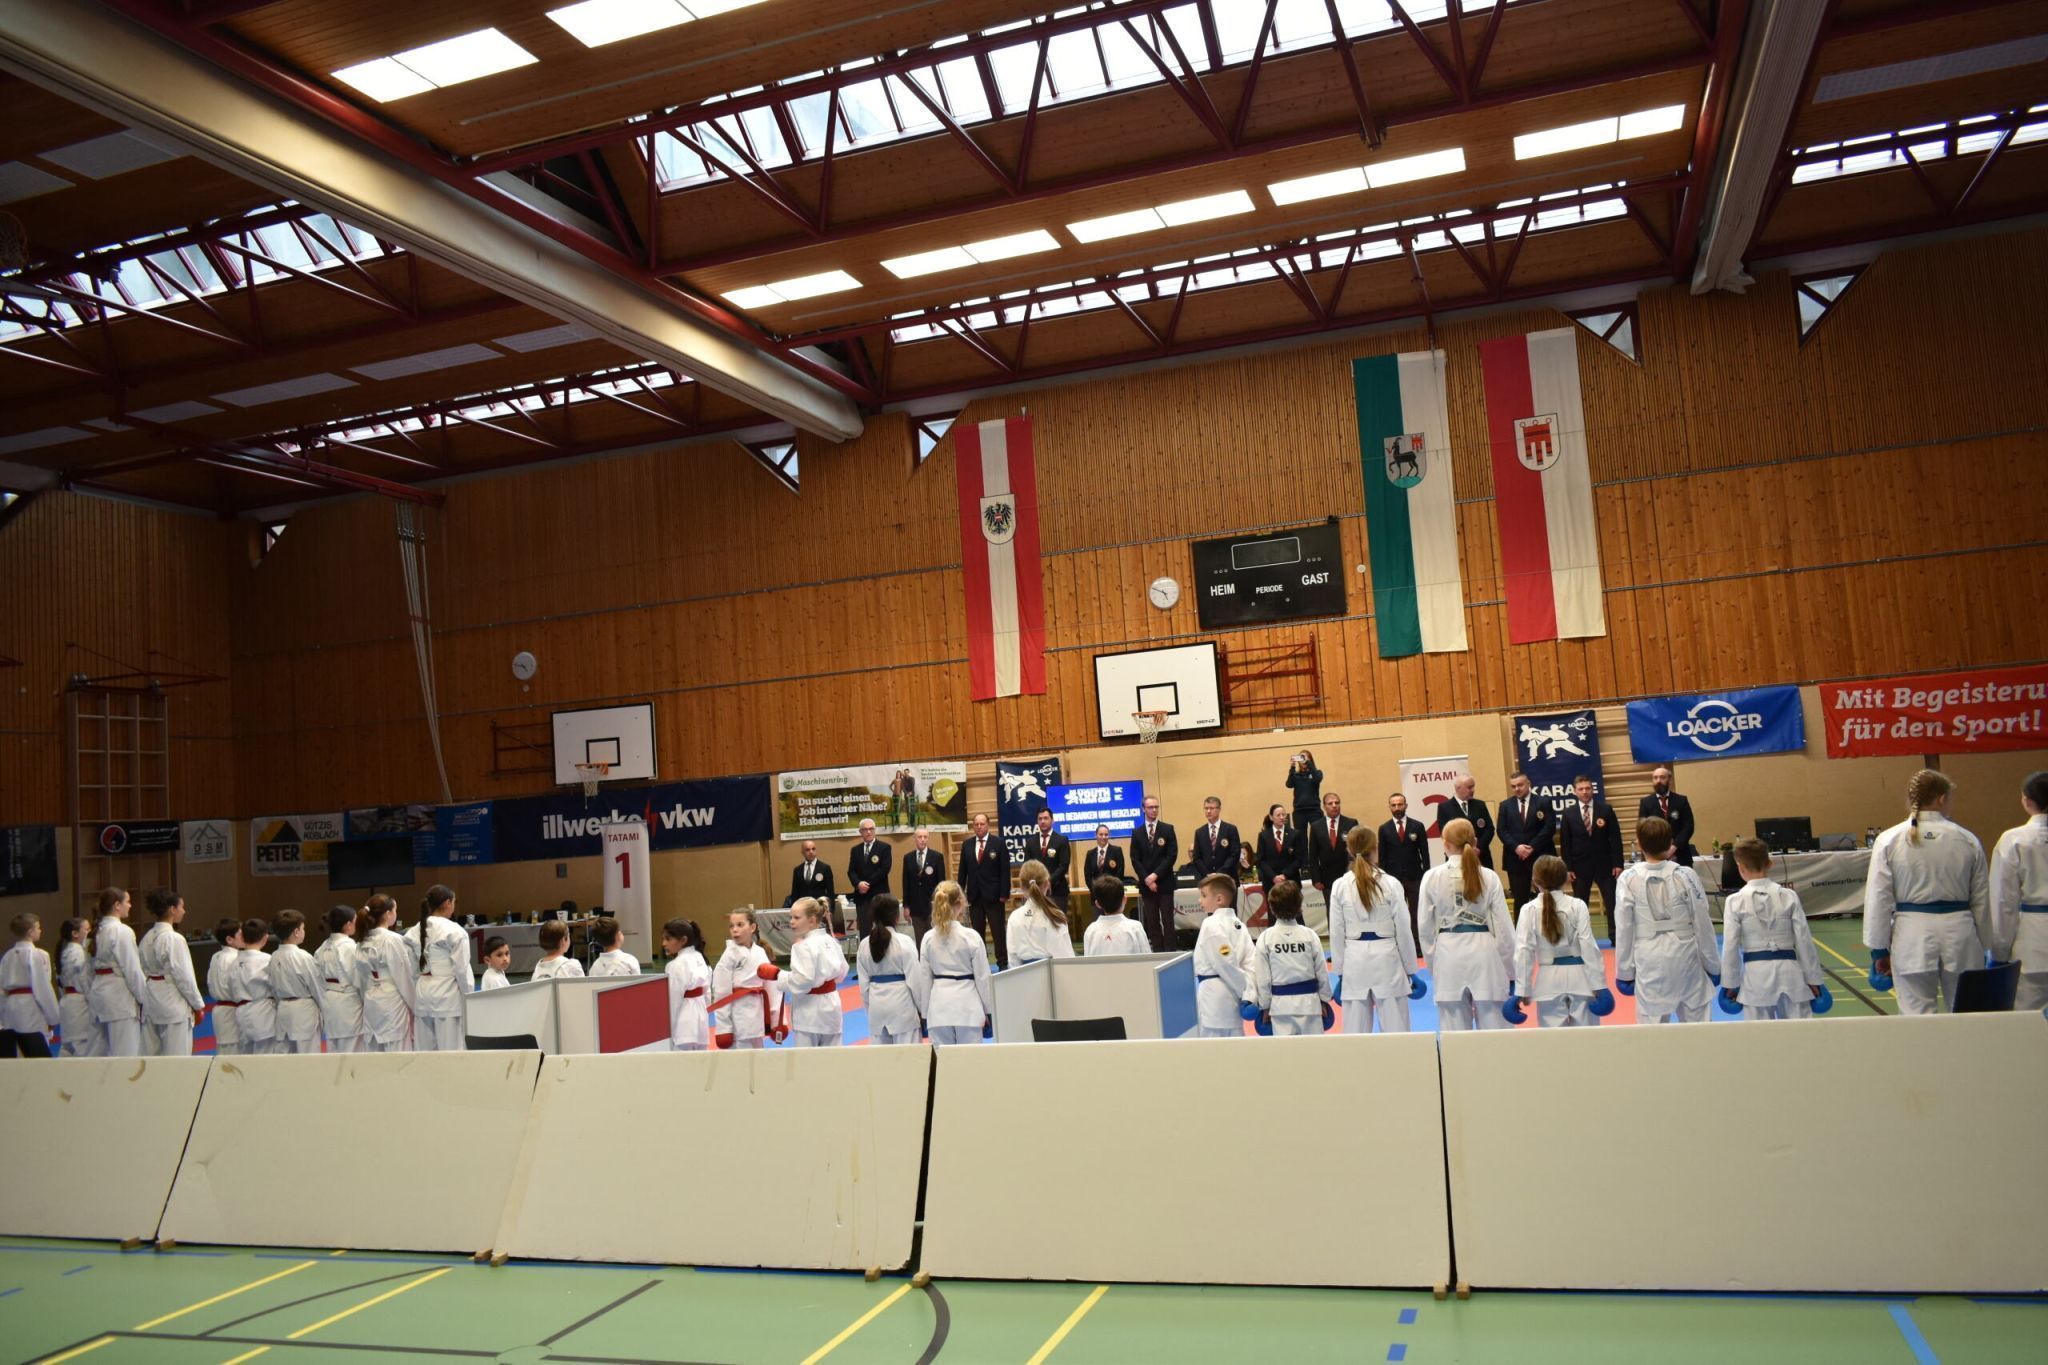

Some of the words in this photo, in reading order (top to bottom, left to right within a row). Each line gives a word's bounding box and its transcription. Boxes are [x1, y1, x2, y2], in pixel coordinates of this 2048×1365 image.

[1301, 572, 1330, 586] GAST
[1210, 583, 1236, 597] HEIM
[1255, 584, 1284, 594] PERIODE
[1835, 688, 1885, 710] Mit
[1892, 681, 2048, 713] Begeisteru
[1667, 713, 1763, 737] LOACKER
[1839, 717, 1886, 748] für
[1891, 716, 1944, 738] den
[1951, 709, 2041, 742] Sport!
[796, 775, 848, 786] Maschinenring
[1413, 771, 1457, 783] TATAMI
[1531, 782, 1599, 797] KARAE
[798, 797, 811, 806] Du
[812, 794, 842, 805] suchst
[843, 793, 871, 803] einen
[798, 807, 816, 816] Job
[816, 806, 827, 815] in
[827, 804, 858, 814] deiner
[858, 802, 888, 812] Nähe?
[1111, 808, 1141, 819] HERZLICH
[659, 803, 715, 830] vkw
[799, 816, 830, 827] Haben
[830, 815, 849, 824] wir!
[1003, 824, 1040, 837] KARA
[1100, 820, 1135, 830] ONSOREN
[608, 832, 640, 843] TATAMI
[257, 844, 300, 863] PETER
[615, 852, 631, 889] 1
[1244, 885, 1270, 928] 2
[1274, 942, 1306, 954] SVEN
